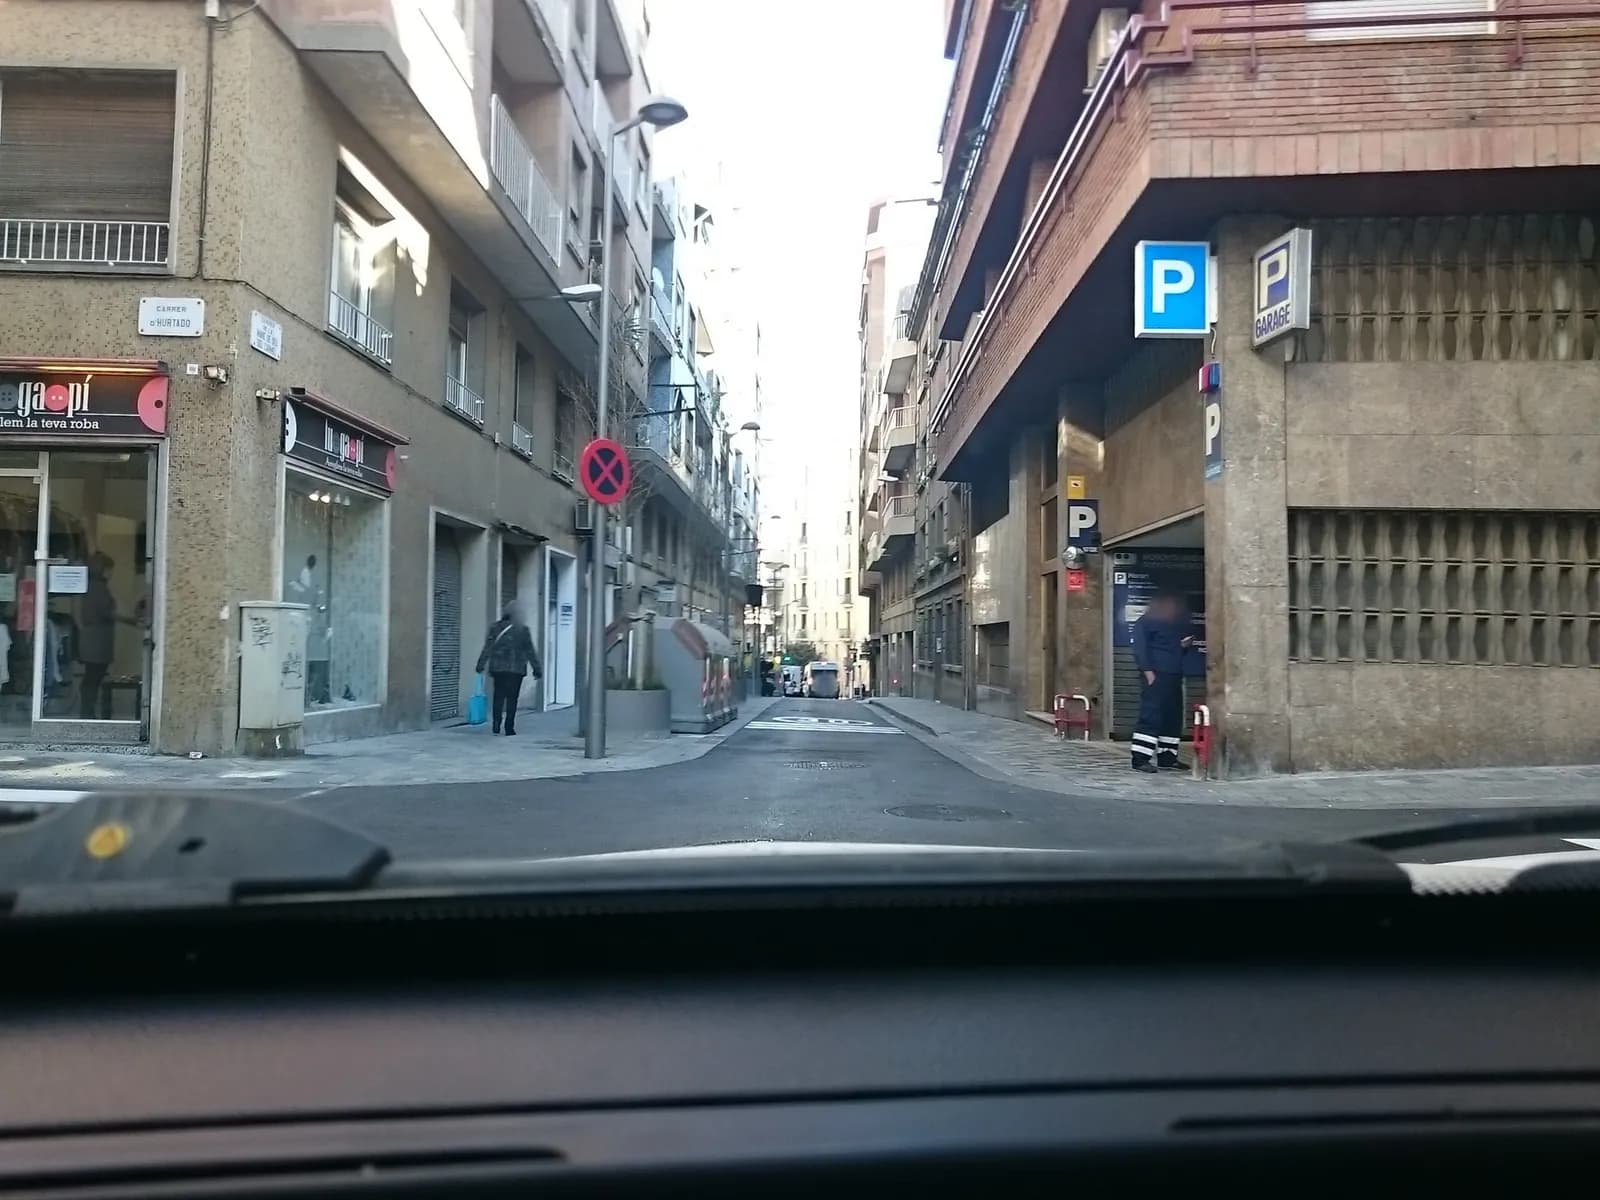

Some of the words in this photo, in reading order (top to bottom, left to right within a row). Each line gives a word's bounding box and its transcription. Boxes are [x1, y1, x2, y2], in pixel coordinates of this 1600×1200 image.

[1152, 259, 1195, 313] P
[1258, 248, 1288, 310] P
[156, 305, 187, 313] CARRER
[1255, 303, 1291, 339] GARAGE
[26, 417, 38, 428] la
[41, 418, 67, 429] teva
[70, 418, 99, 429] roba
[1206, 403, 1220, 456] P
[1069, 506, 1097, 537] P
[1116, 573, 1124, 583] P
